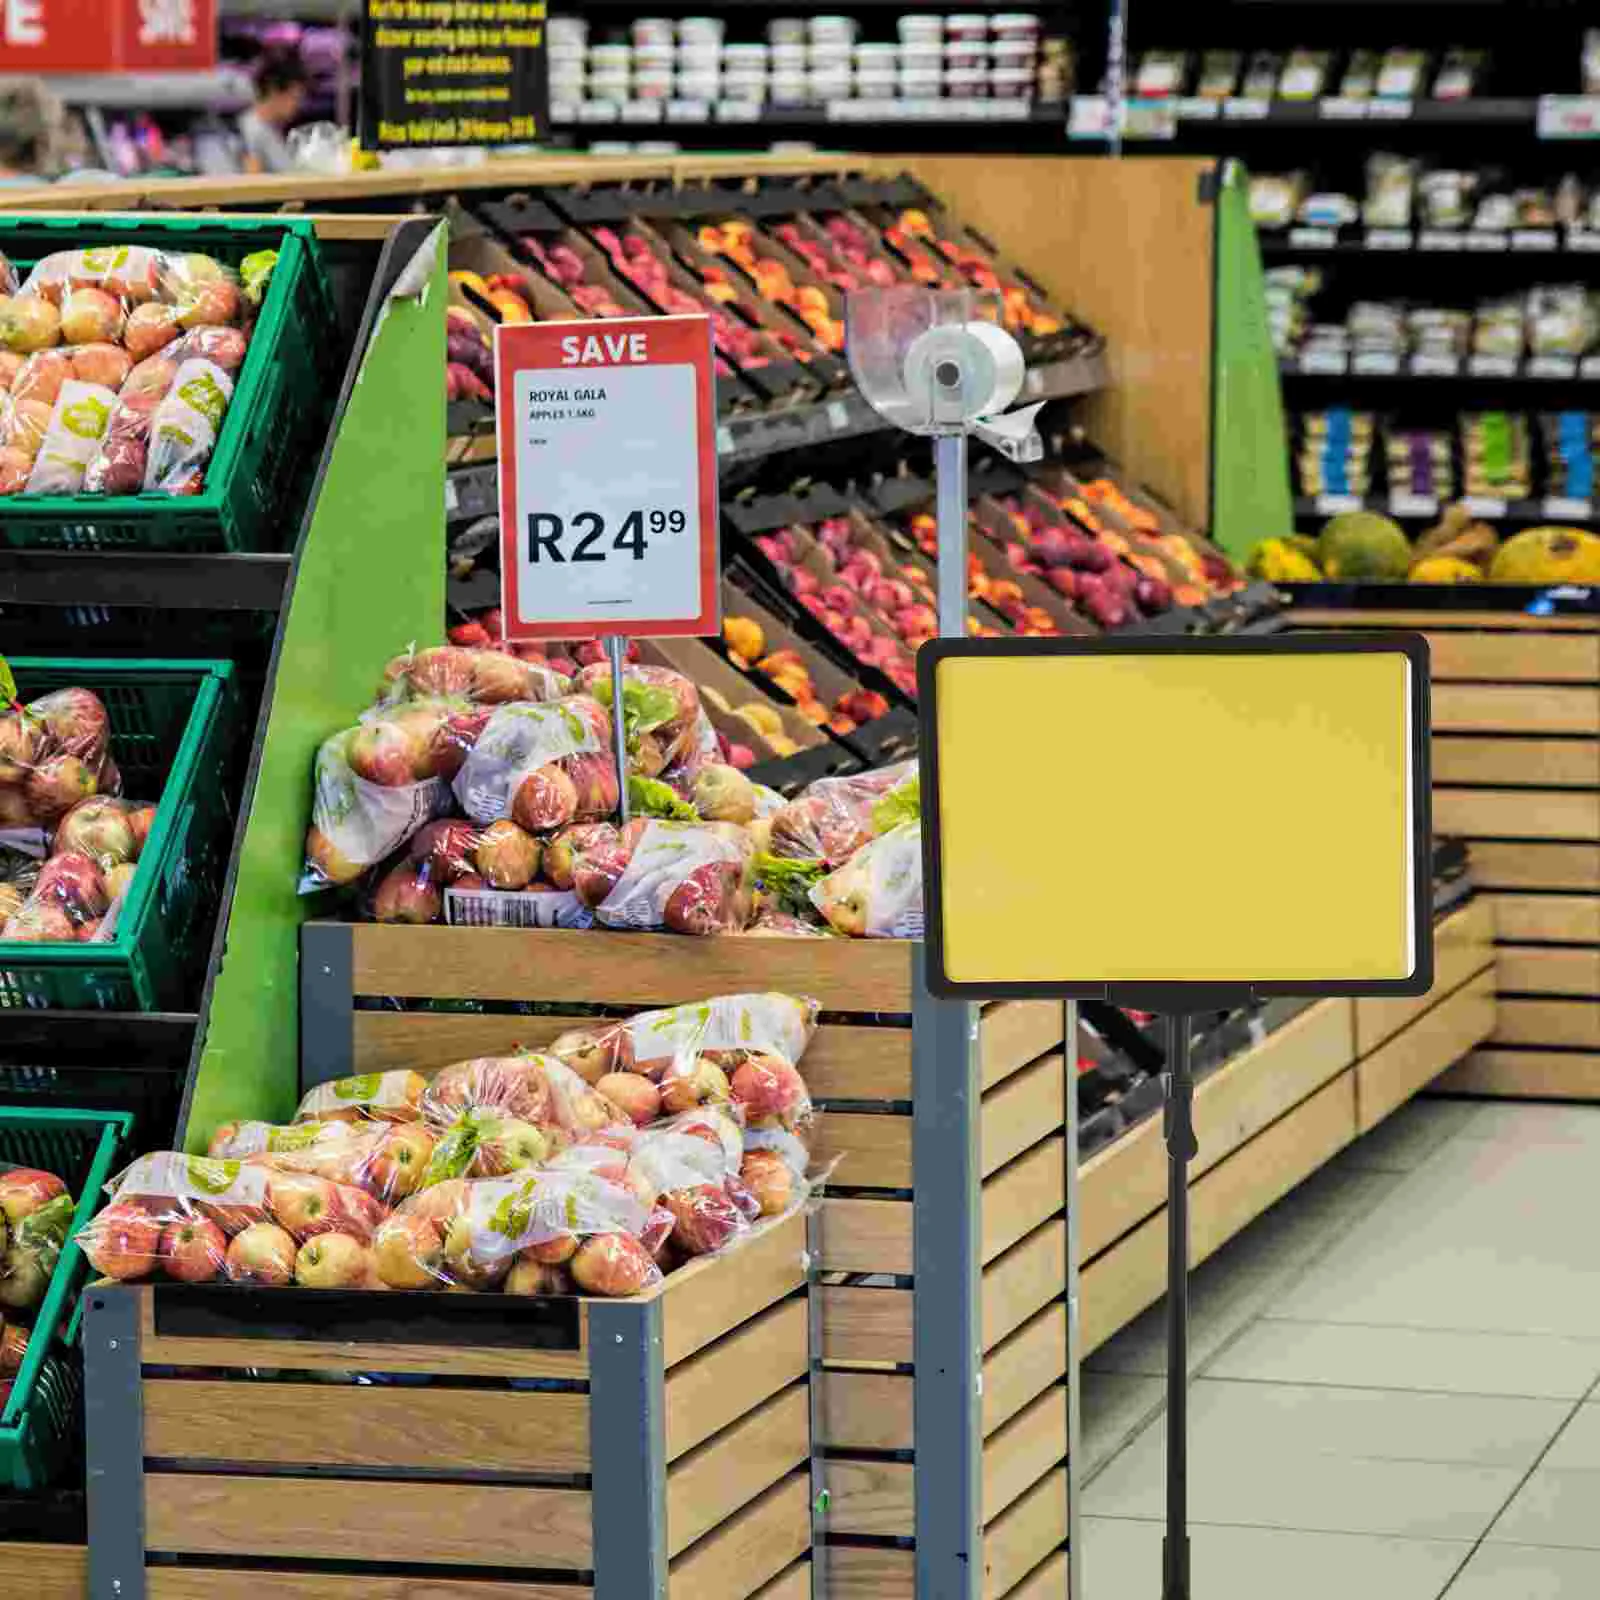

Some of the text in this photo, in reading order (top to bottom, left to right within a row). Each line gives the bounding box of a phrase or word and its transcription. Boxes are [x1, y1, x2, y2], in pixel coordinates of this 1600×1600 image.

[561, 333, 649, 365] SAVE
[529, 387, 607, 402] ROYAL GALA
[529, 409, 565, 420] APPLES
